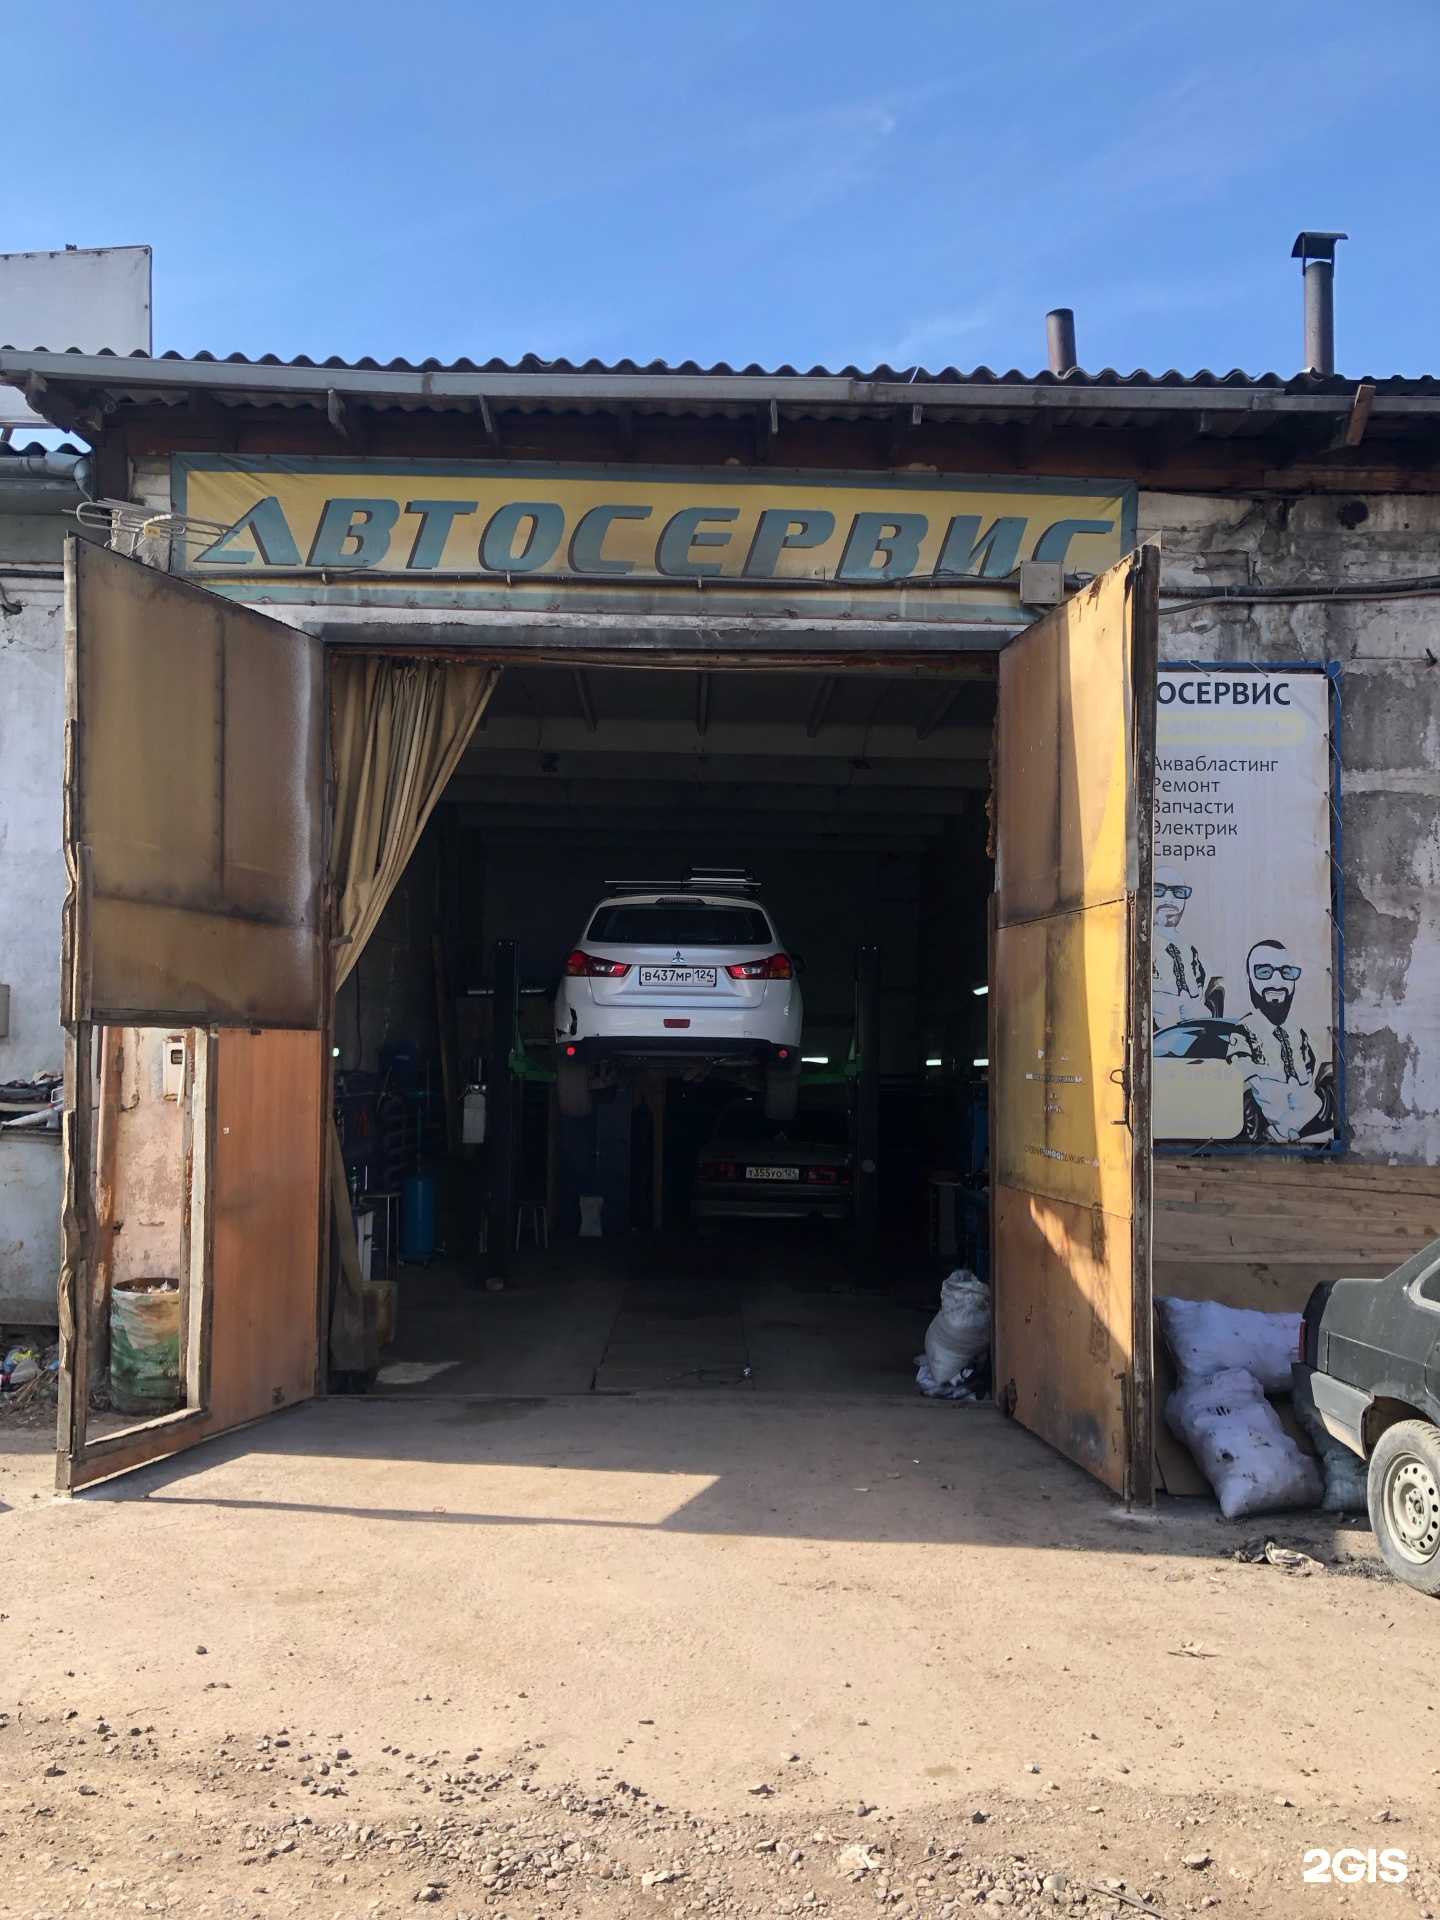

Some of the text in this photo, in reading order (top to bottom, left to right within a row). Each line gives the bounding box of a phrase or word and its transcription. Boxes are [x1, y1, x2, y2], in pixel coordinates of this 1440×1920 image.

[192, 496, 1115, 579] АВТОСЕРВИС
[1154, 755, 1279, 772] Аквабластинг
[1153, 777, 1221, 793] Ремонт
[1153, 799, 1234, 814] Запчасти
[1153, 820, 1238, 839] Электрик
[644, 969, 712, 981] В437МР 124
